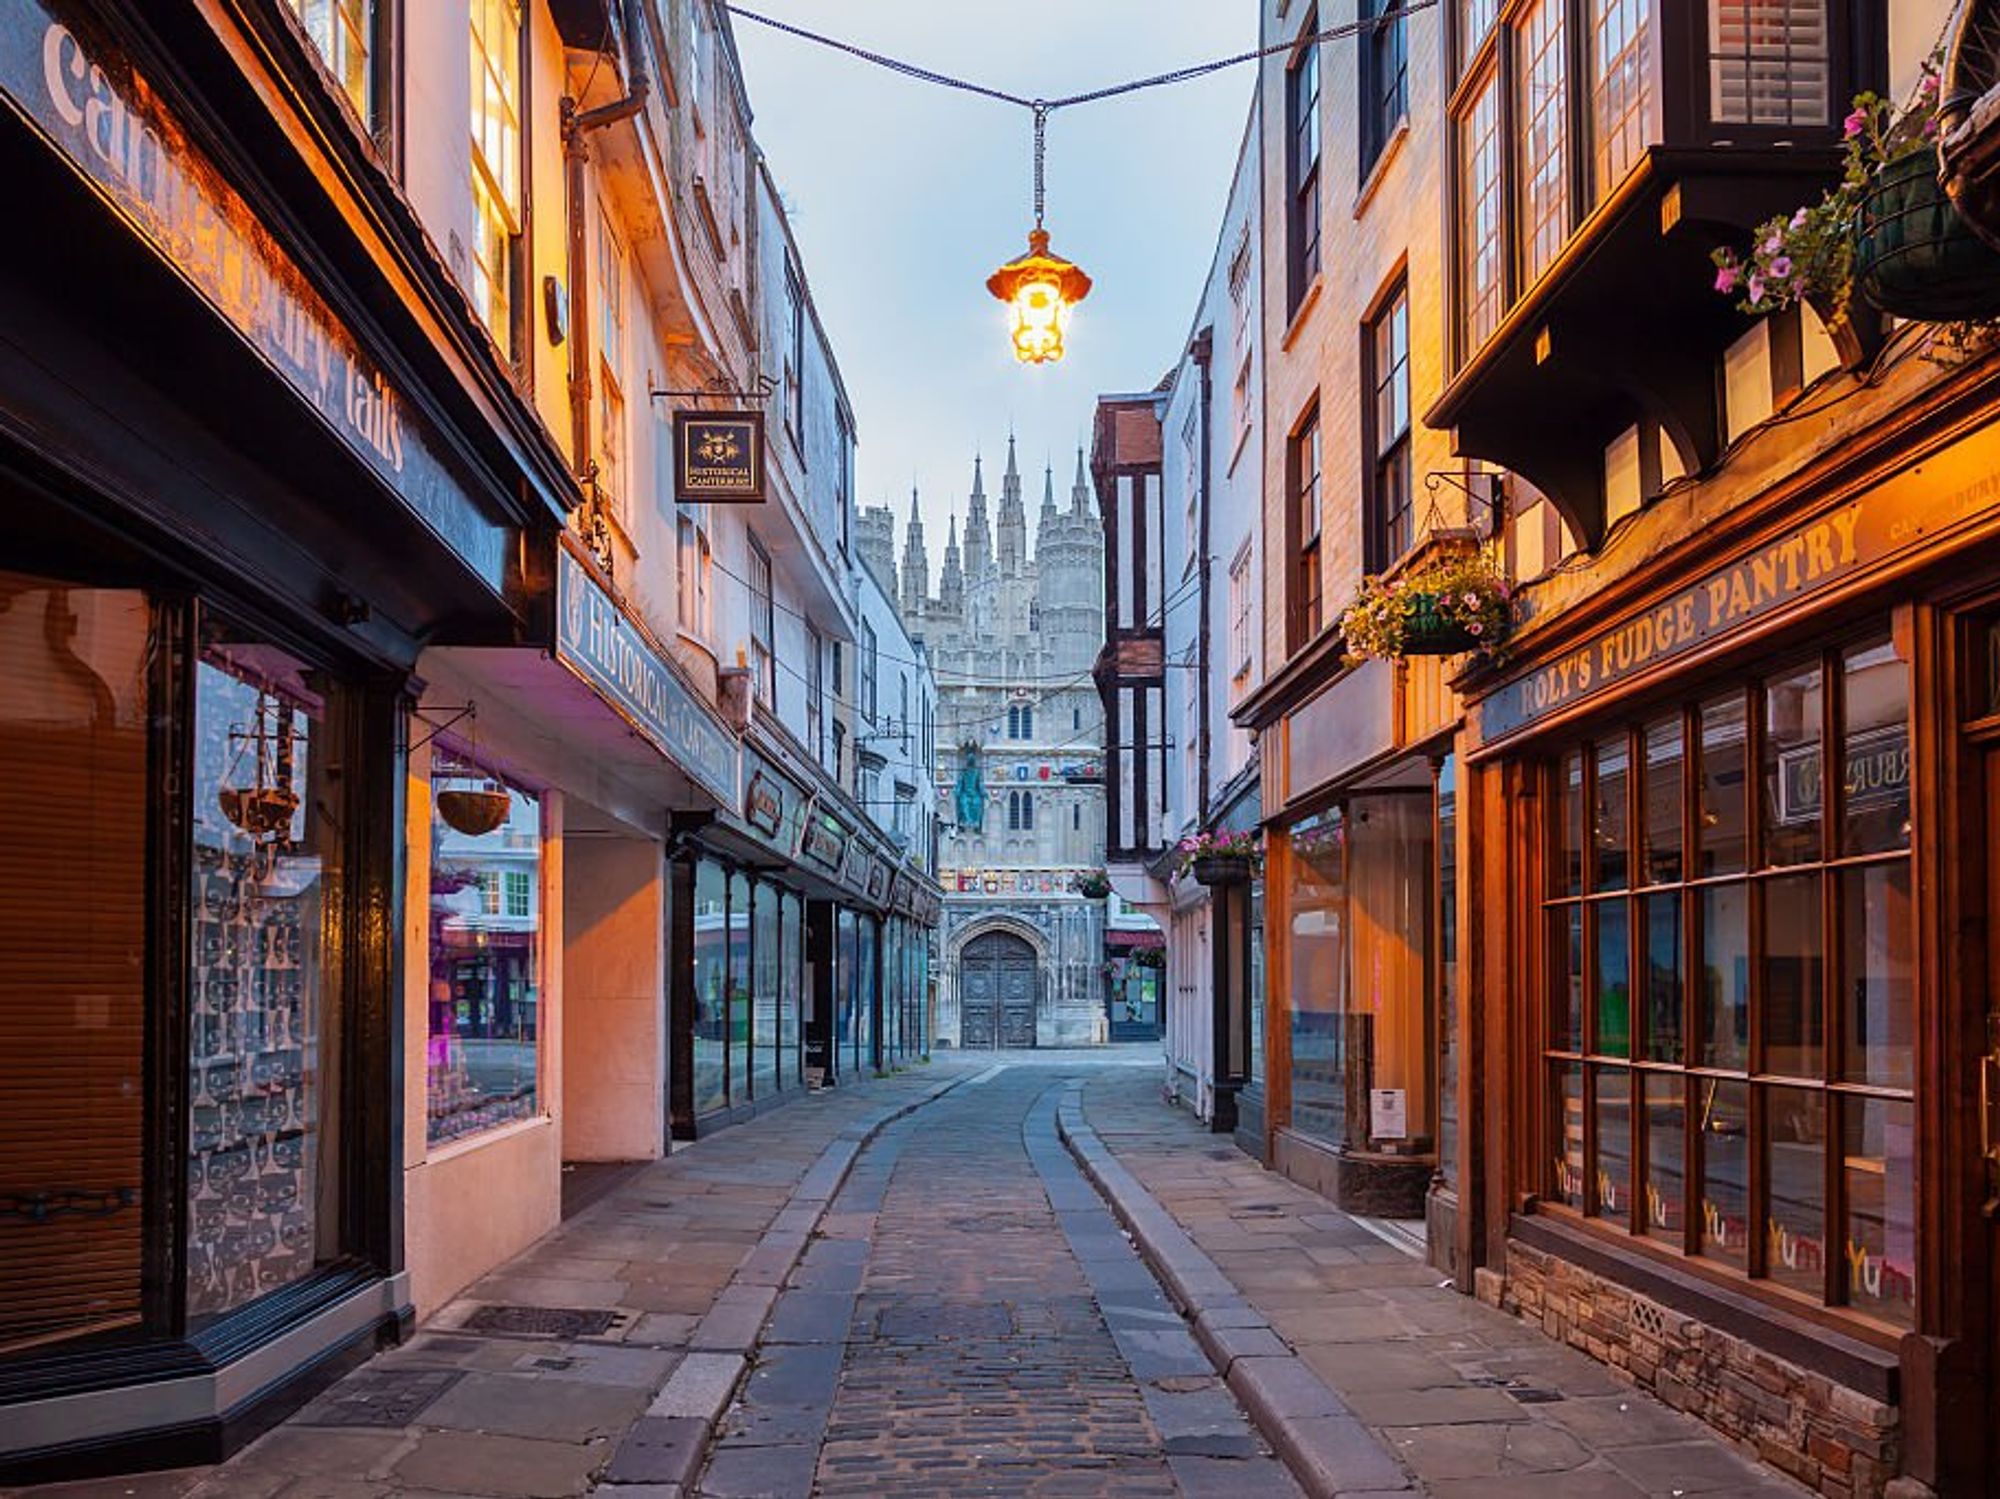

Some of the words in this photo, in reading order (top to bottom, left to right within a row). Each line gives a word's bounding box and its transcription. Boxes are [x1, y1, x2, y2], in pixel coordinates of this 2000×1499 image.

[346, 351, 404, 475] tails
[588, 590, 668, 728] HISTORICAL
[1521, 649, 1592, 716] ROLY'S
[1600, 597, 1696, 680] FUDGE
[1707, 502, 1864, 628] PANTRY
